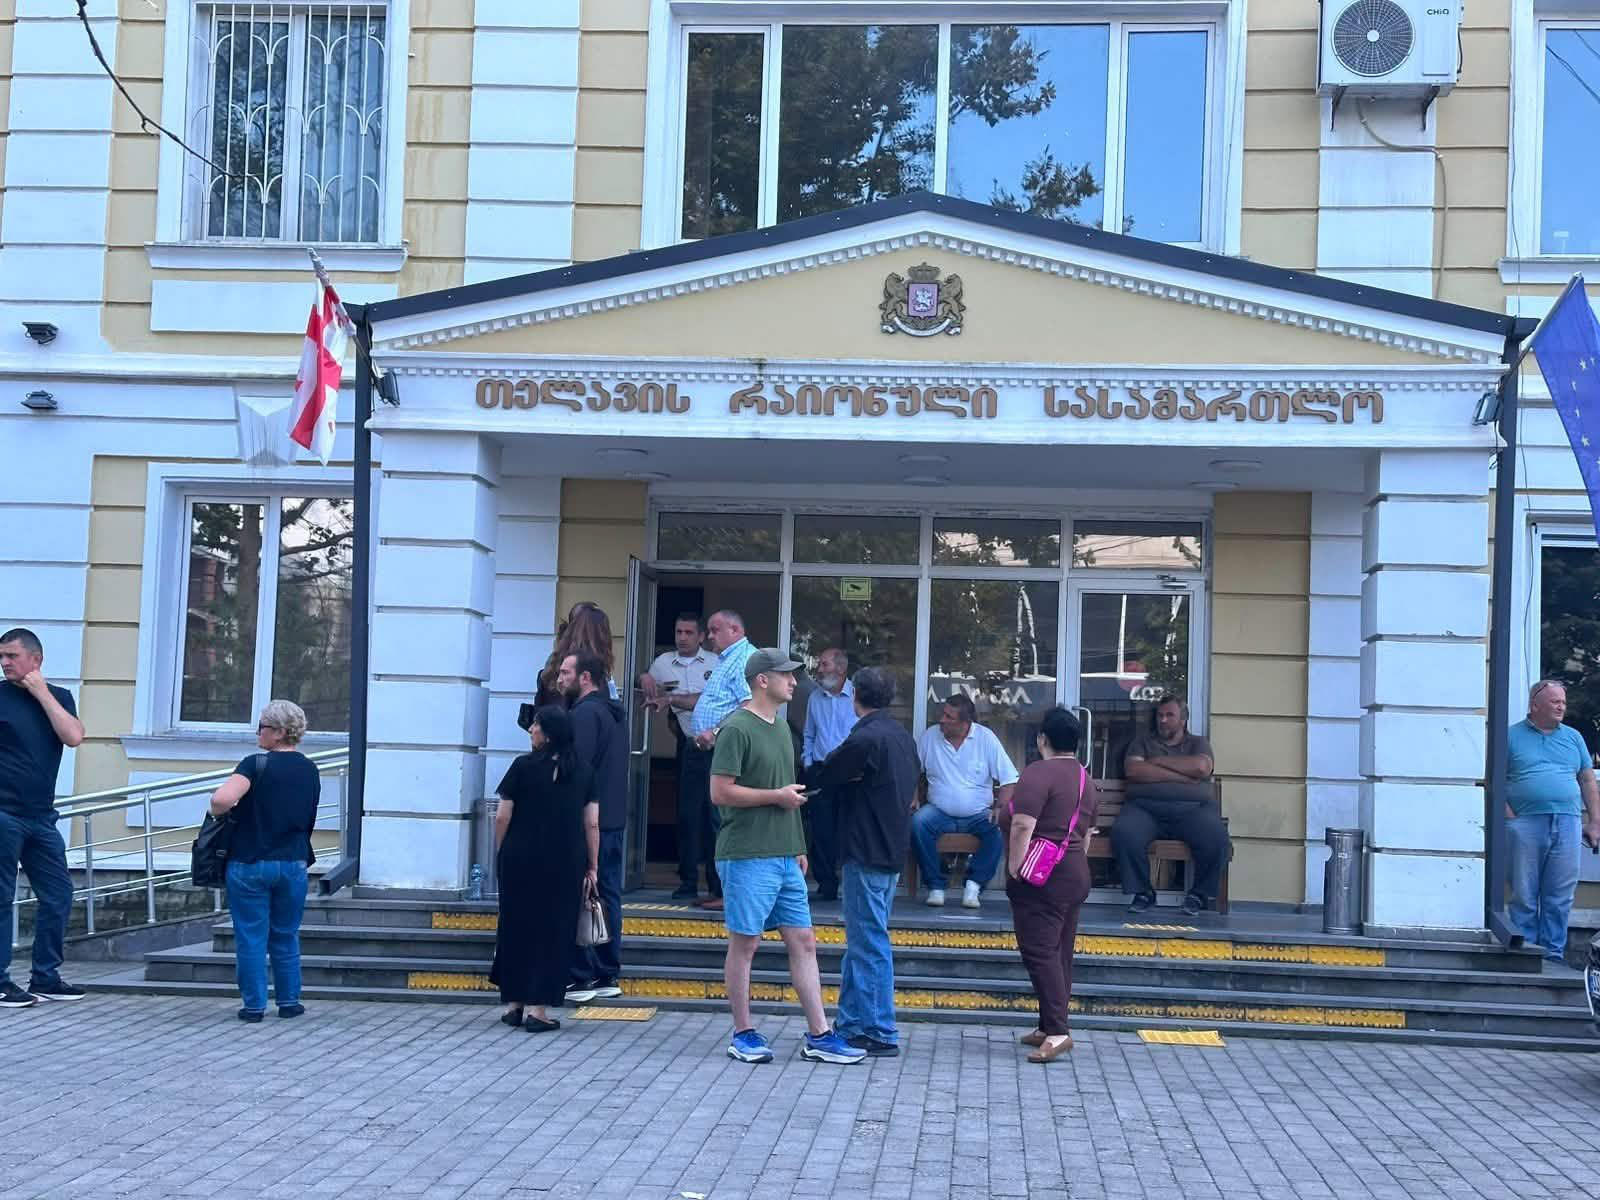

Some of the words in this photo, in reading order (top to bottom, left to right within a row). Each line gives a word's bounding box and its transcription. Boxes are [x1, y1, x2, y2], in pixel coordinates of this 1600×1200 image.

[476, 378, 691, 413] თელავის
[729, 383, 998, 418] რაიონული
[1044, 384, 1384, 423] სასამართლო
